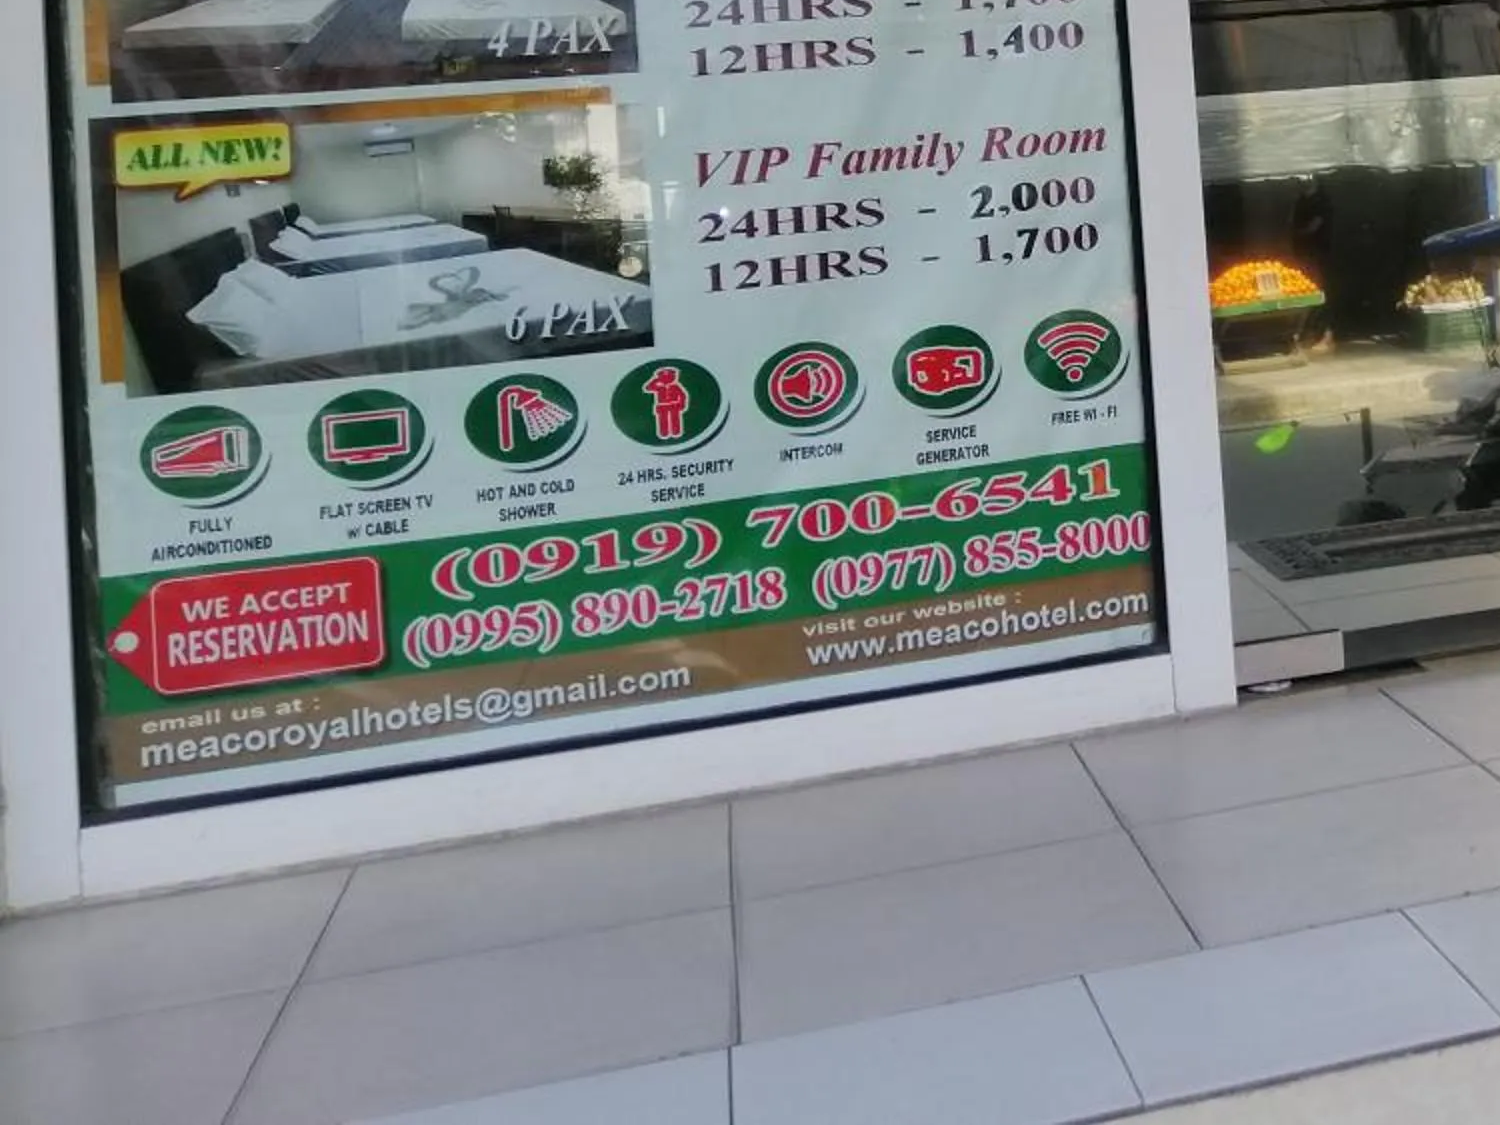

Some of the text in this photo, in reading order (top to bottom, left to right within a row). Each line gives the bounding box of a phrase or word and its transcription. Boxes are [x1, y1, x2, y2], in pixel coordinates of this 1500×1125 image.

[486, 17, 614, 58] 4 PAX
[691, 35, 877, 78] 12HRS
[959, 21, 1084, 59] 1,400
[125, 135, 284, 173] ALL NEW!
[694, 123, 1107, 188] VIP Family Room
[698, 197, 886, 243] 24HRS
[969, 176, 1095, 220] 2,000
[704, 246, 889, 294] 12HRS
[975, 222, 1099, 266] 1,700
[504, 294, 637, 342] 6 PAX
[925, 425, 978, 444] SERVICE
[1051, 411, 1081, 426] FREE
[1107, 406, 1118, 420] FI
[779, 443, 844, 462] INTERCOM
[916, 444, 991, 466] GENERATOR
[476, 478, 576, 504] HOT AND COLD
[617, 458, 735, 486] 24 HRS. SECURITY
[319, 493, 434, 521] FLAT SCREEN TV
[498, 502, 557, 523] SHOWER
[650, 483, 705, 504] SERVICE
[188, 516, 233, 535] FULLY
[364, 519, 410, 538] CABLE
[431, 457, 1121, 600] (0919) 700-6541
[151, 535, 273, 563] AIRCONDITIONED
[182, 581, 354, 622] WE ACCEPT
[402, 510, 1151, 667] (0995) 890-2718 (0977) 855-8000
[803, 593, 1006, 637] visit our website
[806, 591, 1149, 667] www.meacohotel.com
[167, 609, 370, 668] RESERVATION
[140, 665, 692, 769] meacoroyalhotels@gmail.com
[141, 698, 304, 735] email us at
